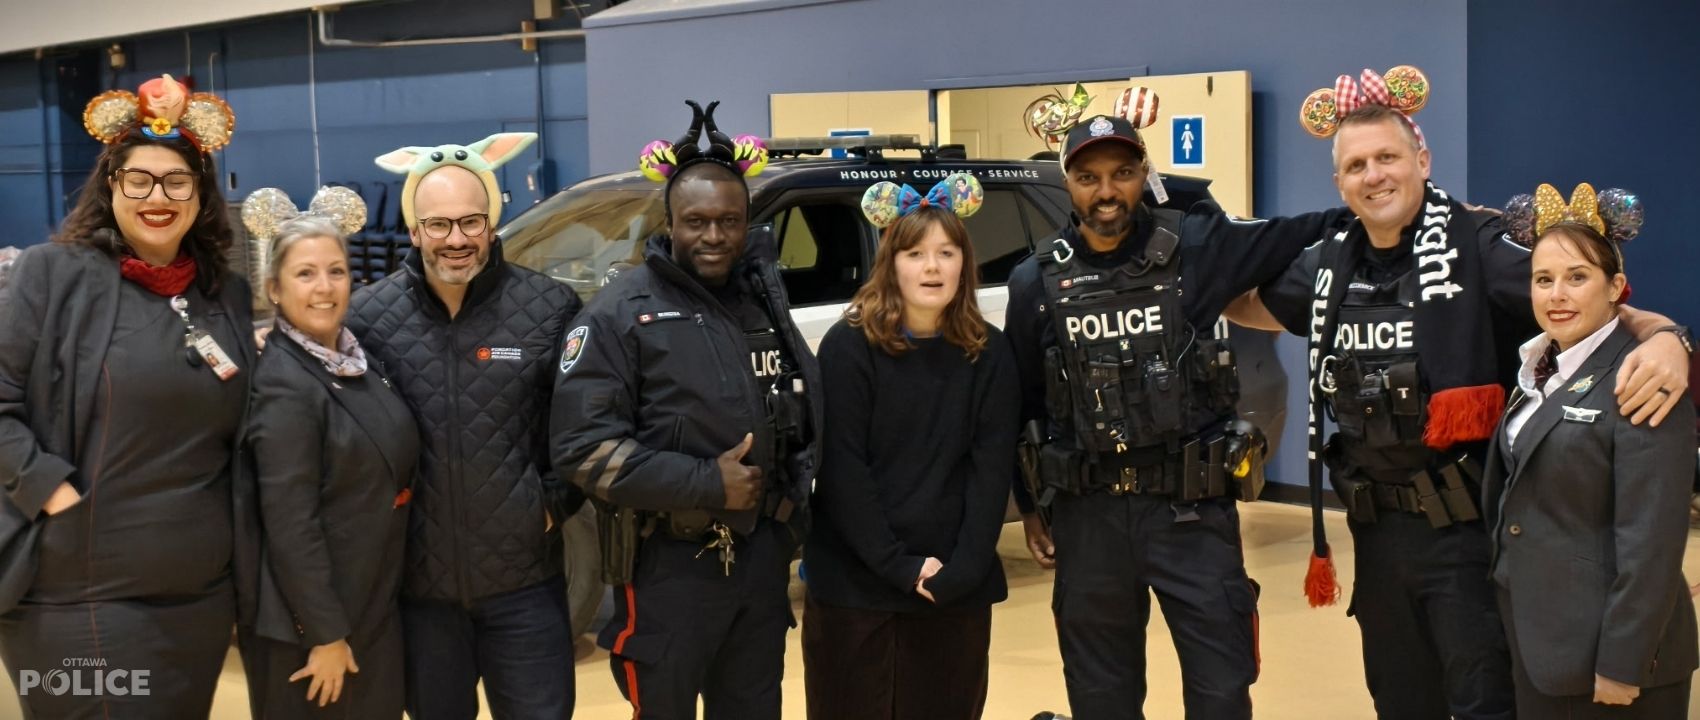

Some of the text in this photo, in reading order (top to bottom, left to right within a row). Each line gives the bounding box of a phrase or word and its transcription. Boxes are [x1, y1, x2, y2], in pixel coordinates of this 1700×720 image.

[840, 170, 897, 179] HONOUR
[988, 169, 1039, 179] SERVICE
[1066, 305, 1163, 341] POLICE
[751, 350, 782, 377] LICE
